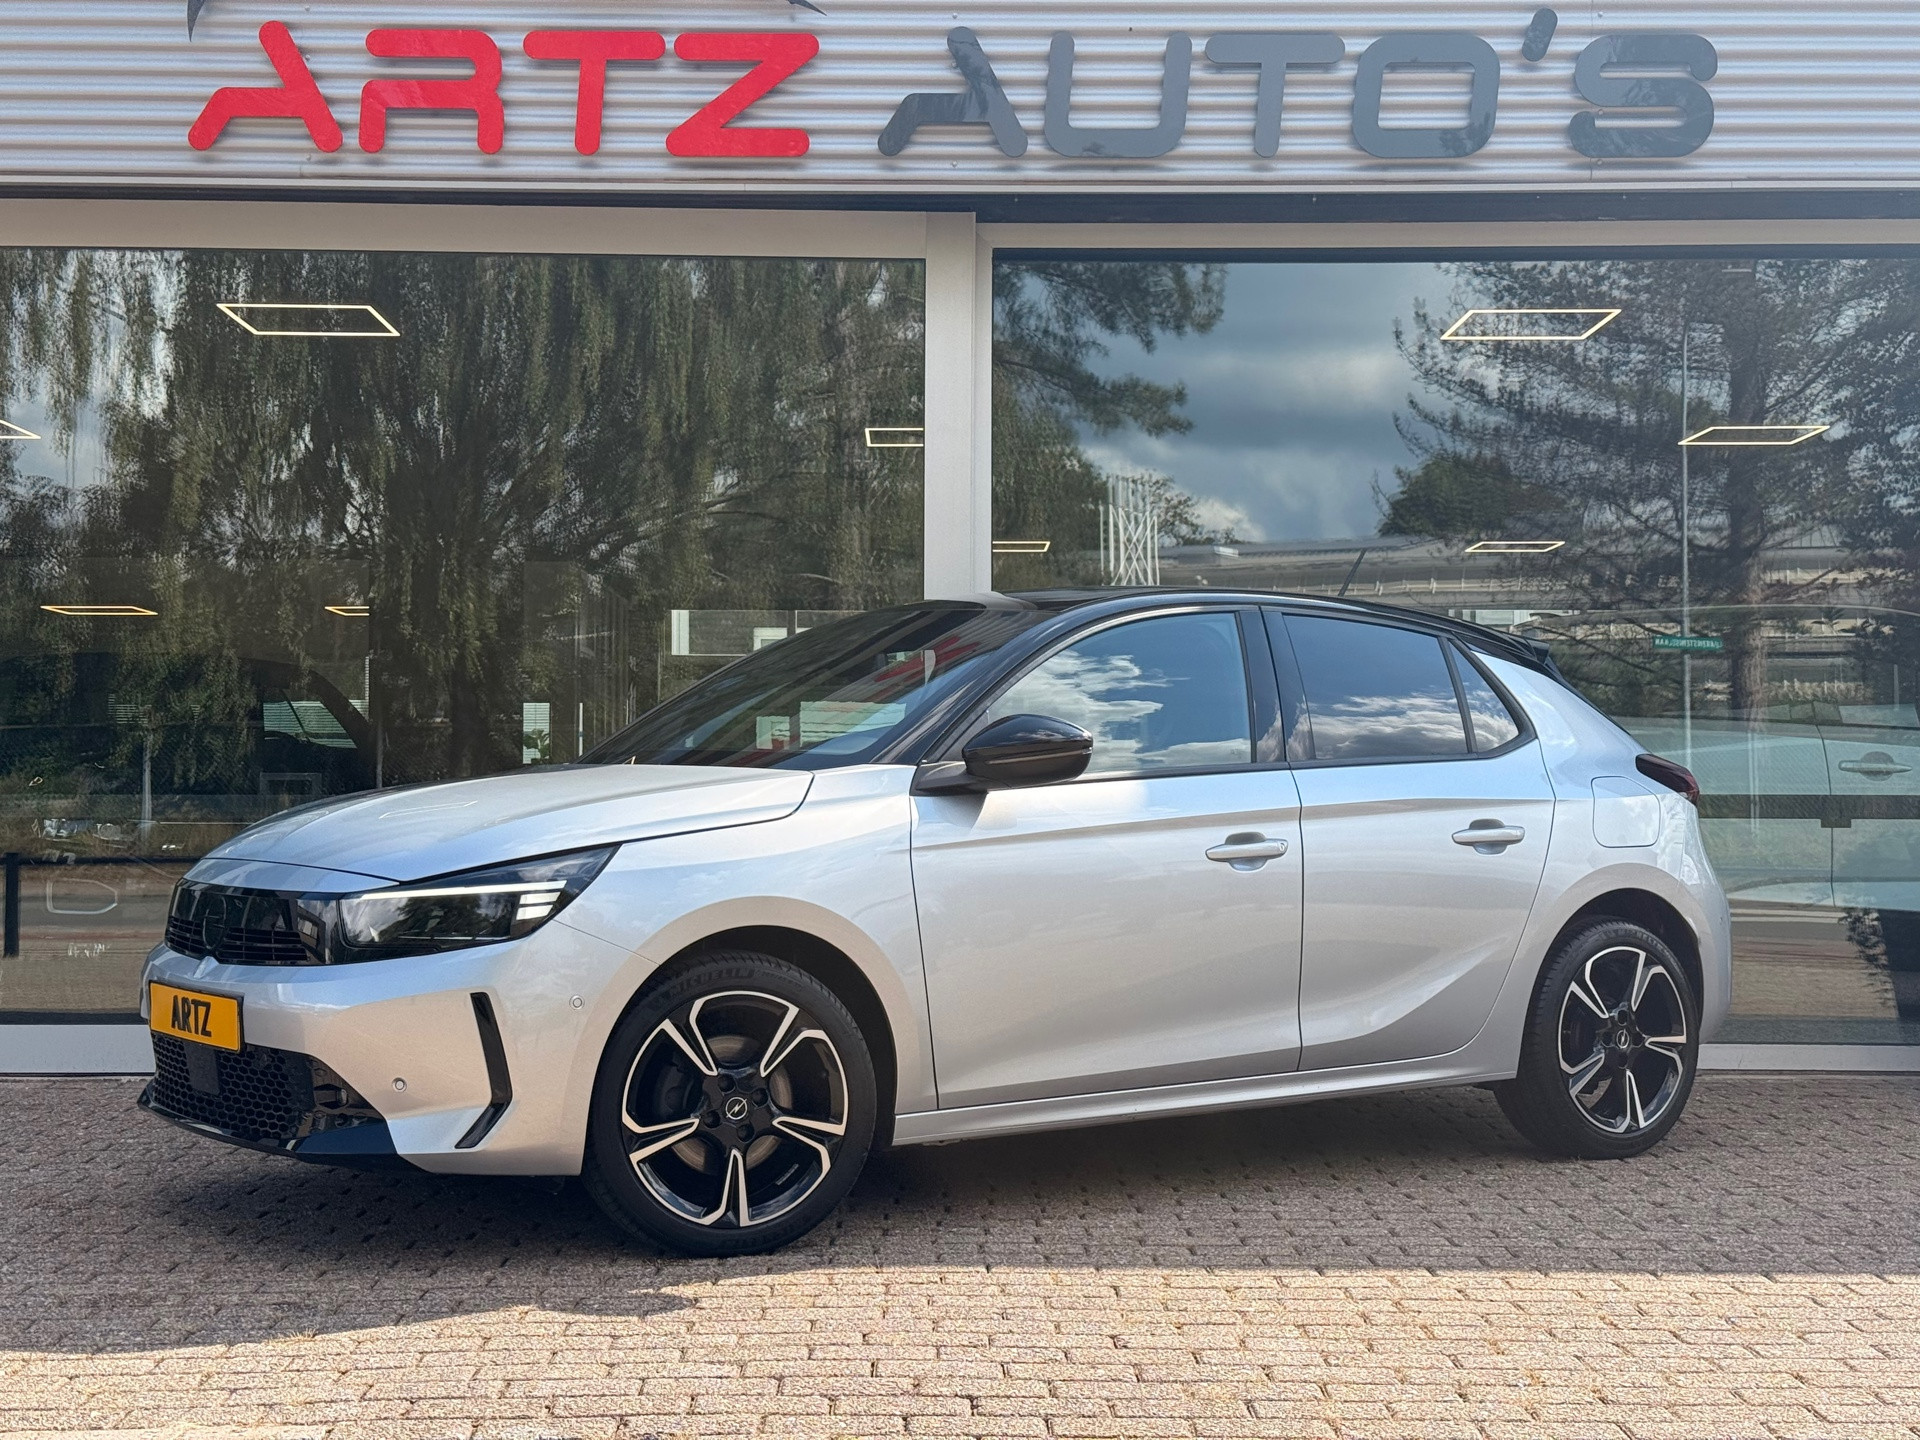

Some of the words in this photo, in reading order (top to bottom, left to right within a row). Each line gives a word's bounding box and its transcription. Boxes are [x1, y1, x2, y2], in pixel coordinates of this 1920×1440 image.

[187, 20, 820, 159] ARTZ
[876, 8, 1719, 159] AUTO'S
[171, 995, 212, 1037] ARTZ
